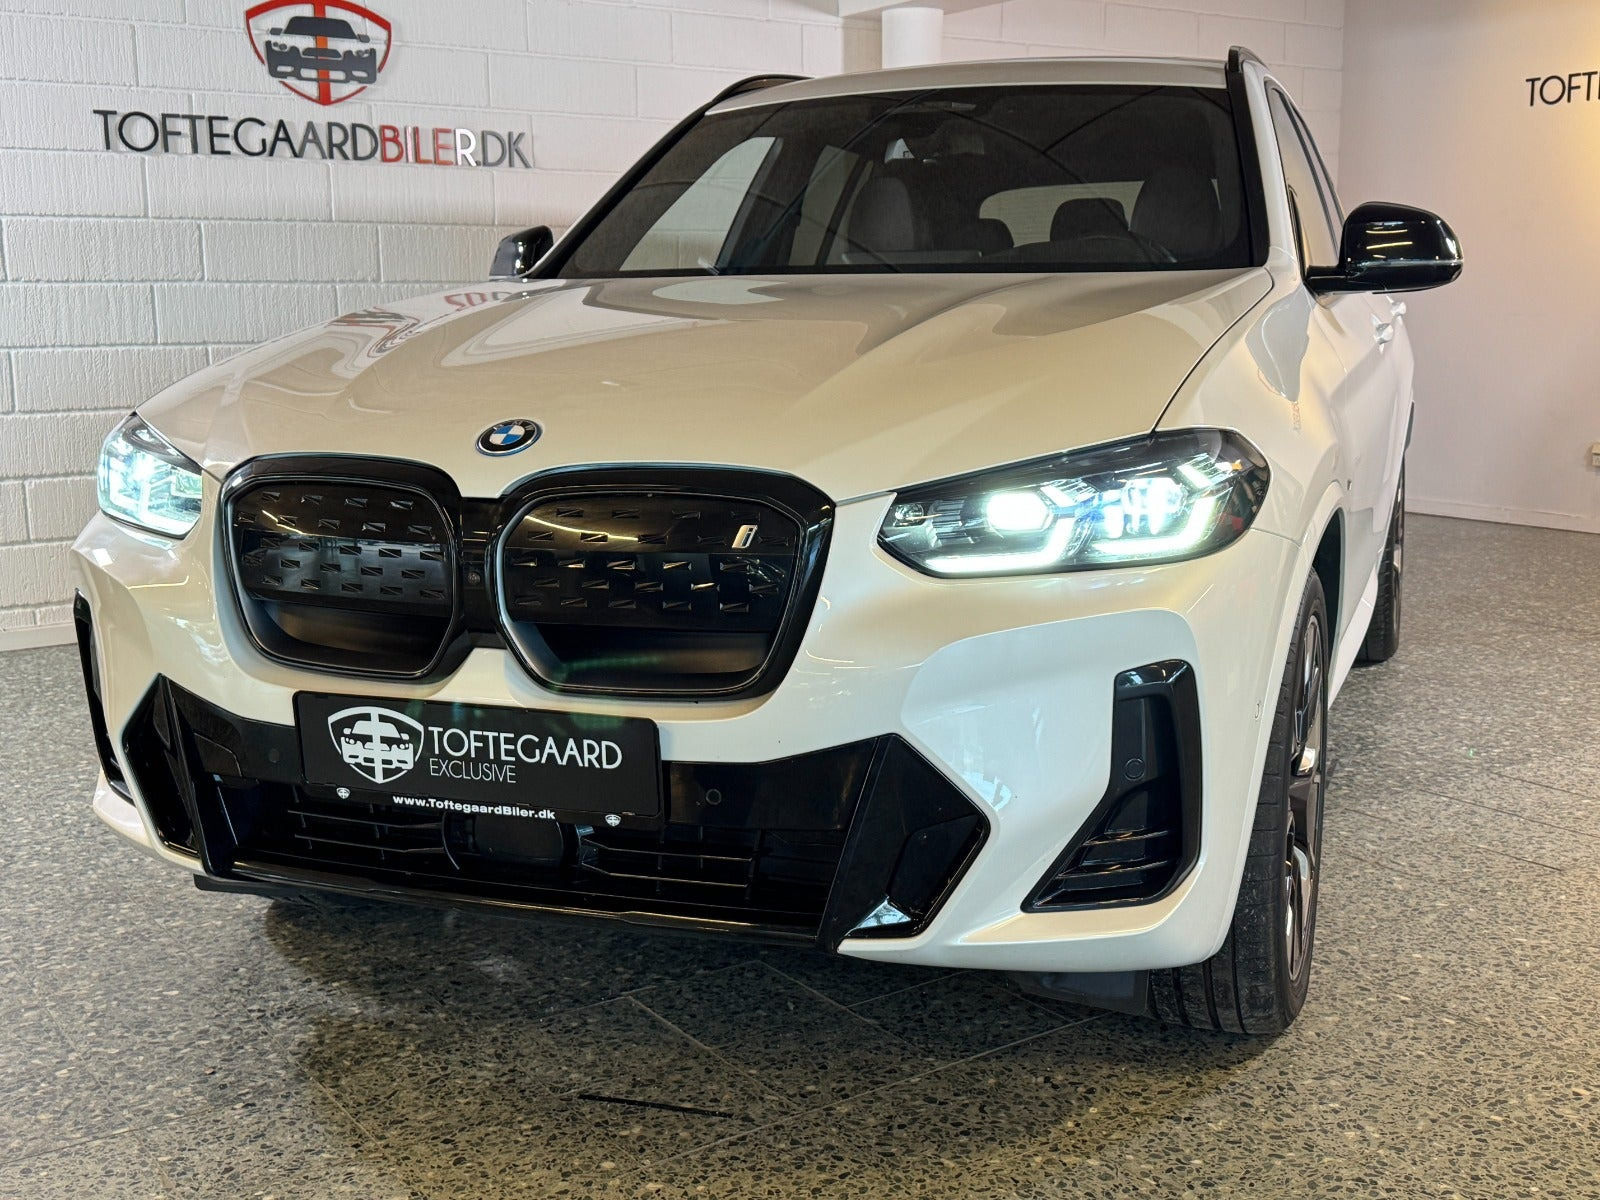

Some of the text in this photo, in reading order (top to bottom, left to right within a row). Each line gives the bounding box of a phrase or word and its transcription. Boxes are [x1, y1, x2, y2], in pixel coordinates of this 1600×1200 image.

[1525, 71, 1600, 107] TOFT
[93, 109, 532, 168] TOFTEGAARDBILER.DK
[428, 726, 622, 769] TOFTEGAARD
[429, 758, 516, 783] EXCLUSIVE
[393, 795, 556, 819] www.ToftegaardBiler.dk
